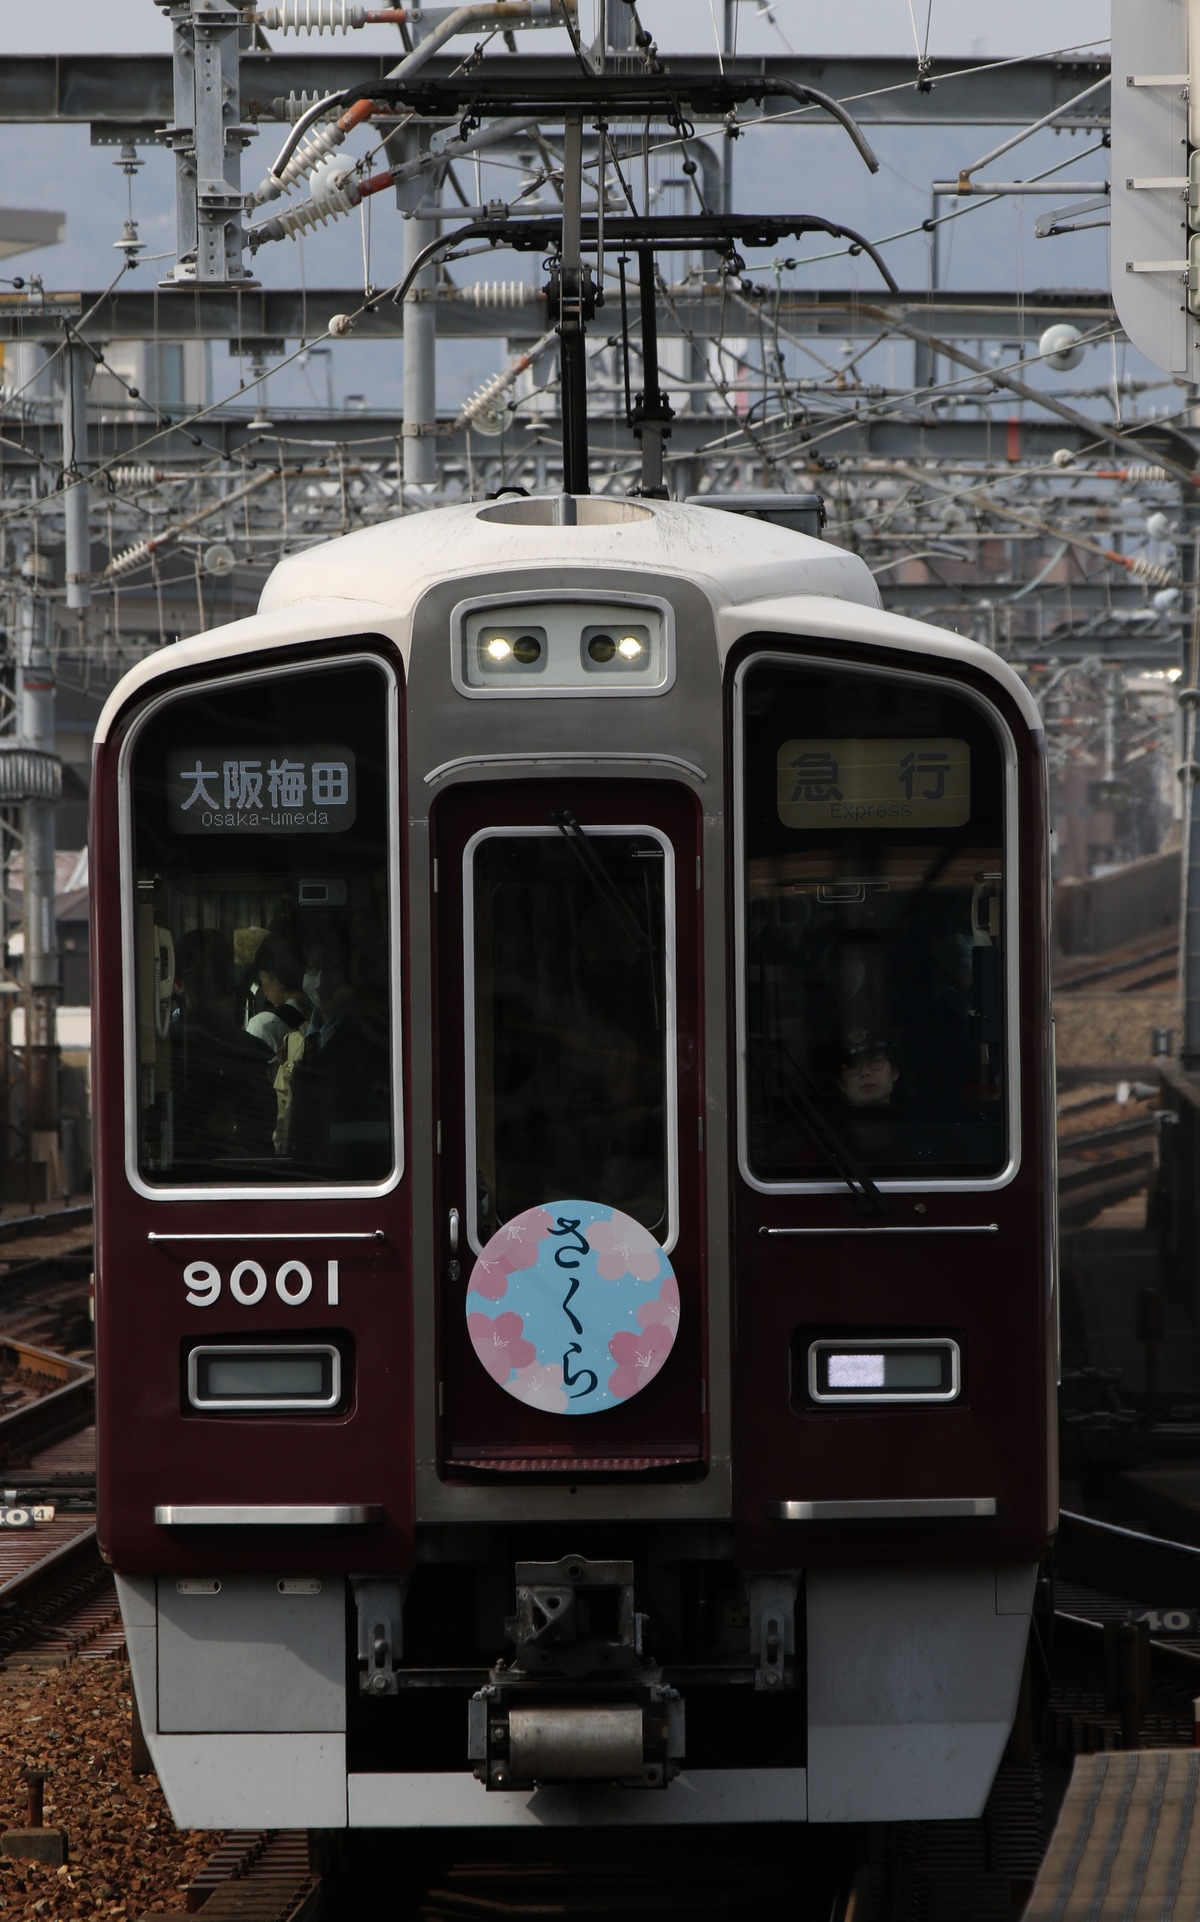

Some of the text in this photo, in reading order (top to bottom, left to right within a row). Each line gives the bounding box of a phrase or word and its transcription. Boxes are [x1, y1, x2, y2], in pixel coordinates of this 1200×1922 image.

[179, 759, 349, 810] 大阪梅田
[791, 751, 951, 802] 急行
[201, 809, 330, 827] Osaka-umeda
[830, 802, 912, 820] Express
[183, 1260, 339, 1307] 9001
[547, 1217, 598, 1399] さくら
[1134, 1611, 1190, 1631] 40
